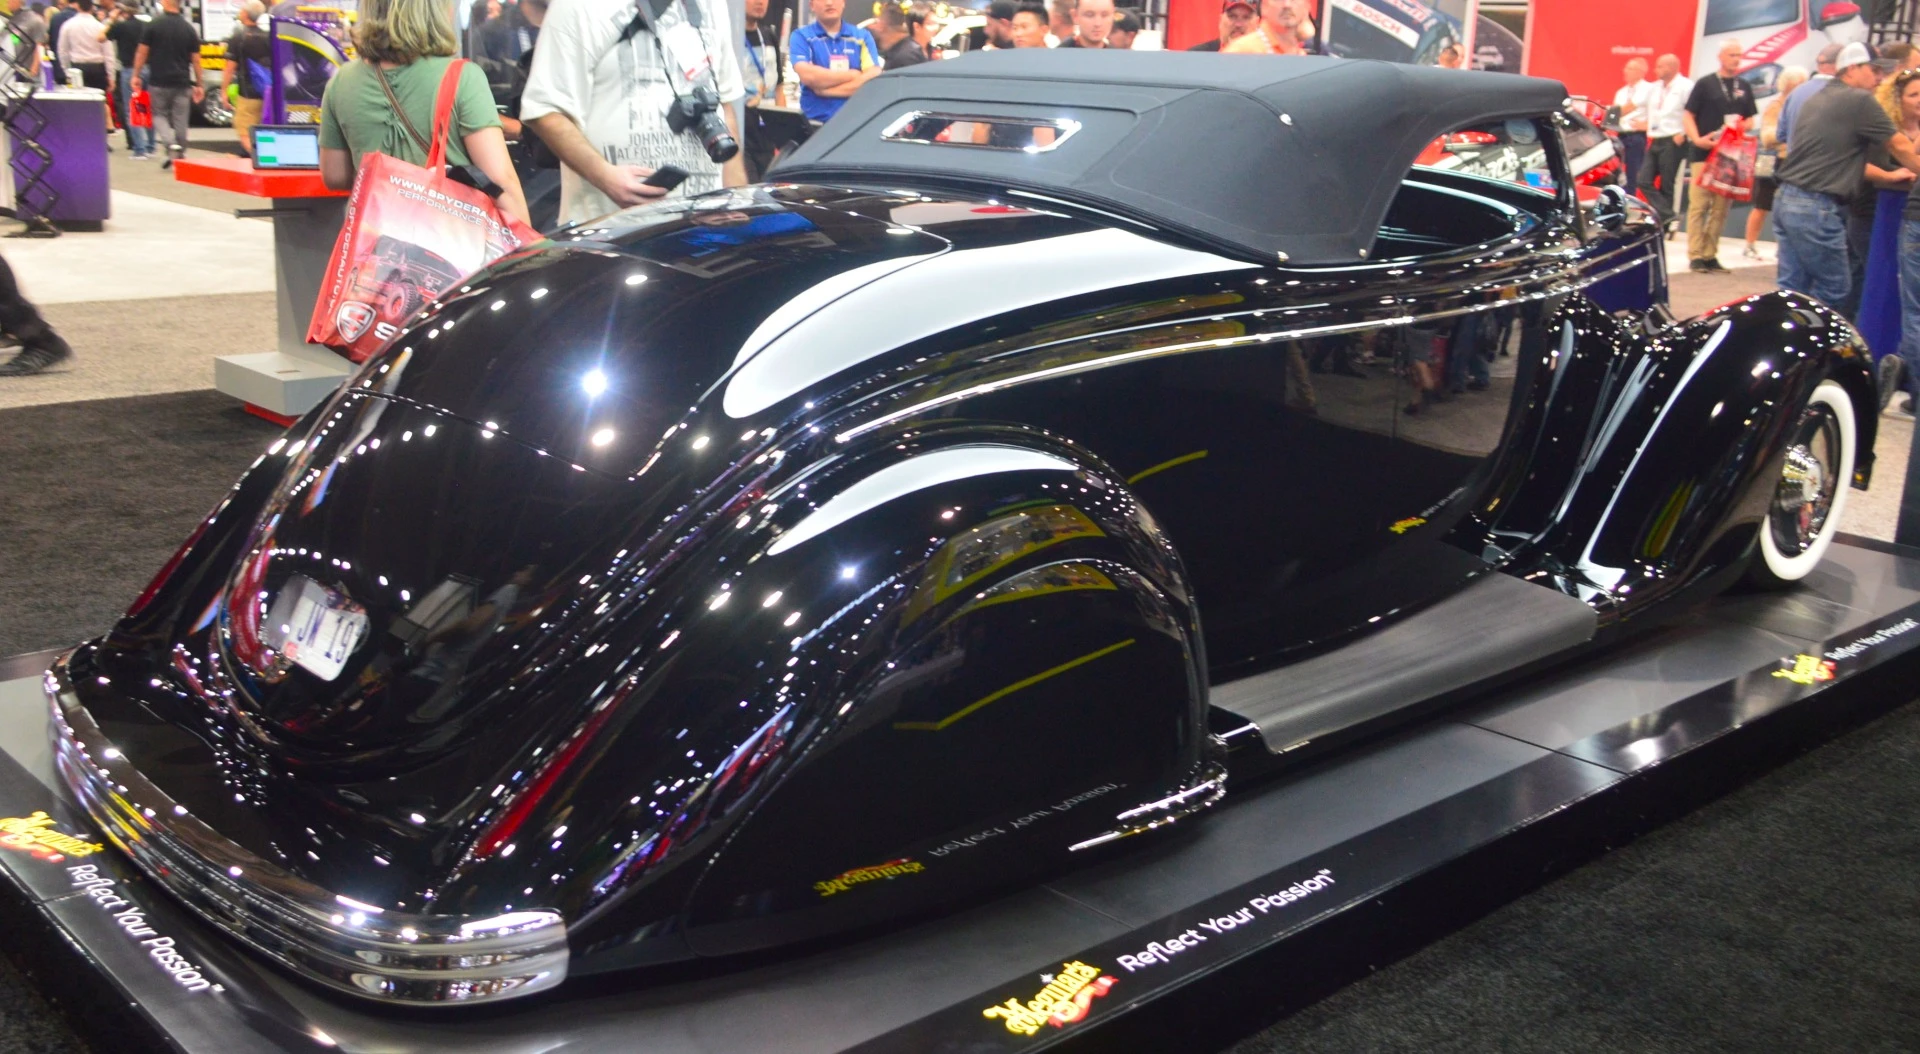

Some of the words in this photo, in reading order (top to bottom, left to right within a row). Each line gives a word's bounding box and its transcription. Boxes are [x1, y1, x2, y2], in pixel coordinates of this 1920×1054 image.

[1352, 4, 1401, 33] BOSCH
[617, 147, 630, 160] AT
[634, 145, 678, 159] FOLSOM
[628, 132, 675, 146] JOHNNY
[397, 188, 482, 226] PERFORMANCE
[66, 863, 129, 909] Reflect
[113, 906, 158, 937] Your
[1116, 928, 1208, 973] Reflect
[1199, 907, 1255, 936] Your
